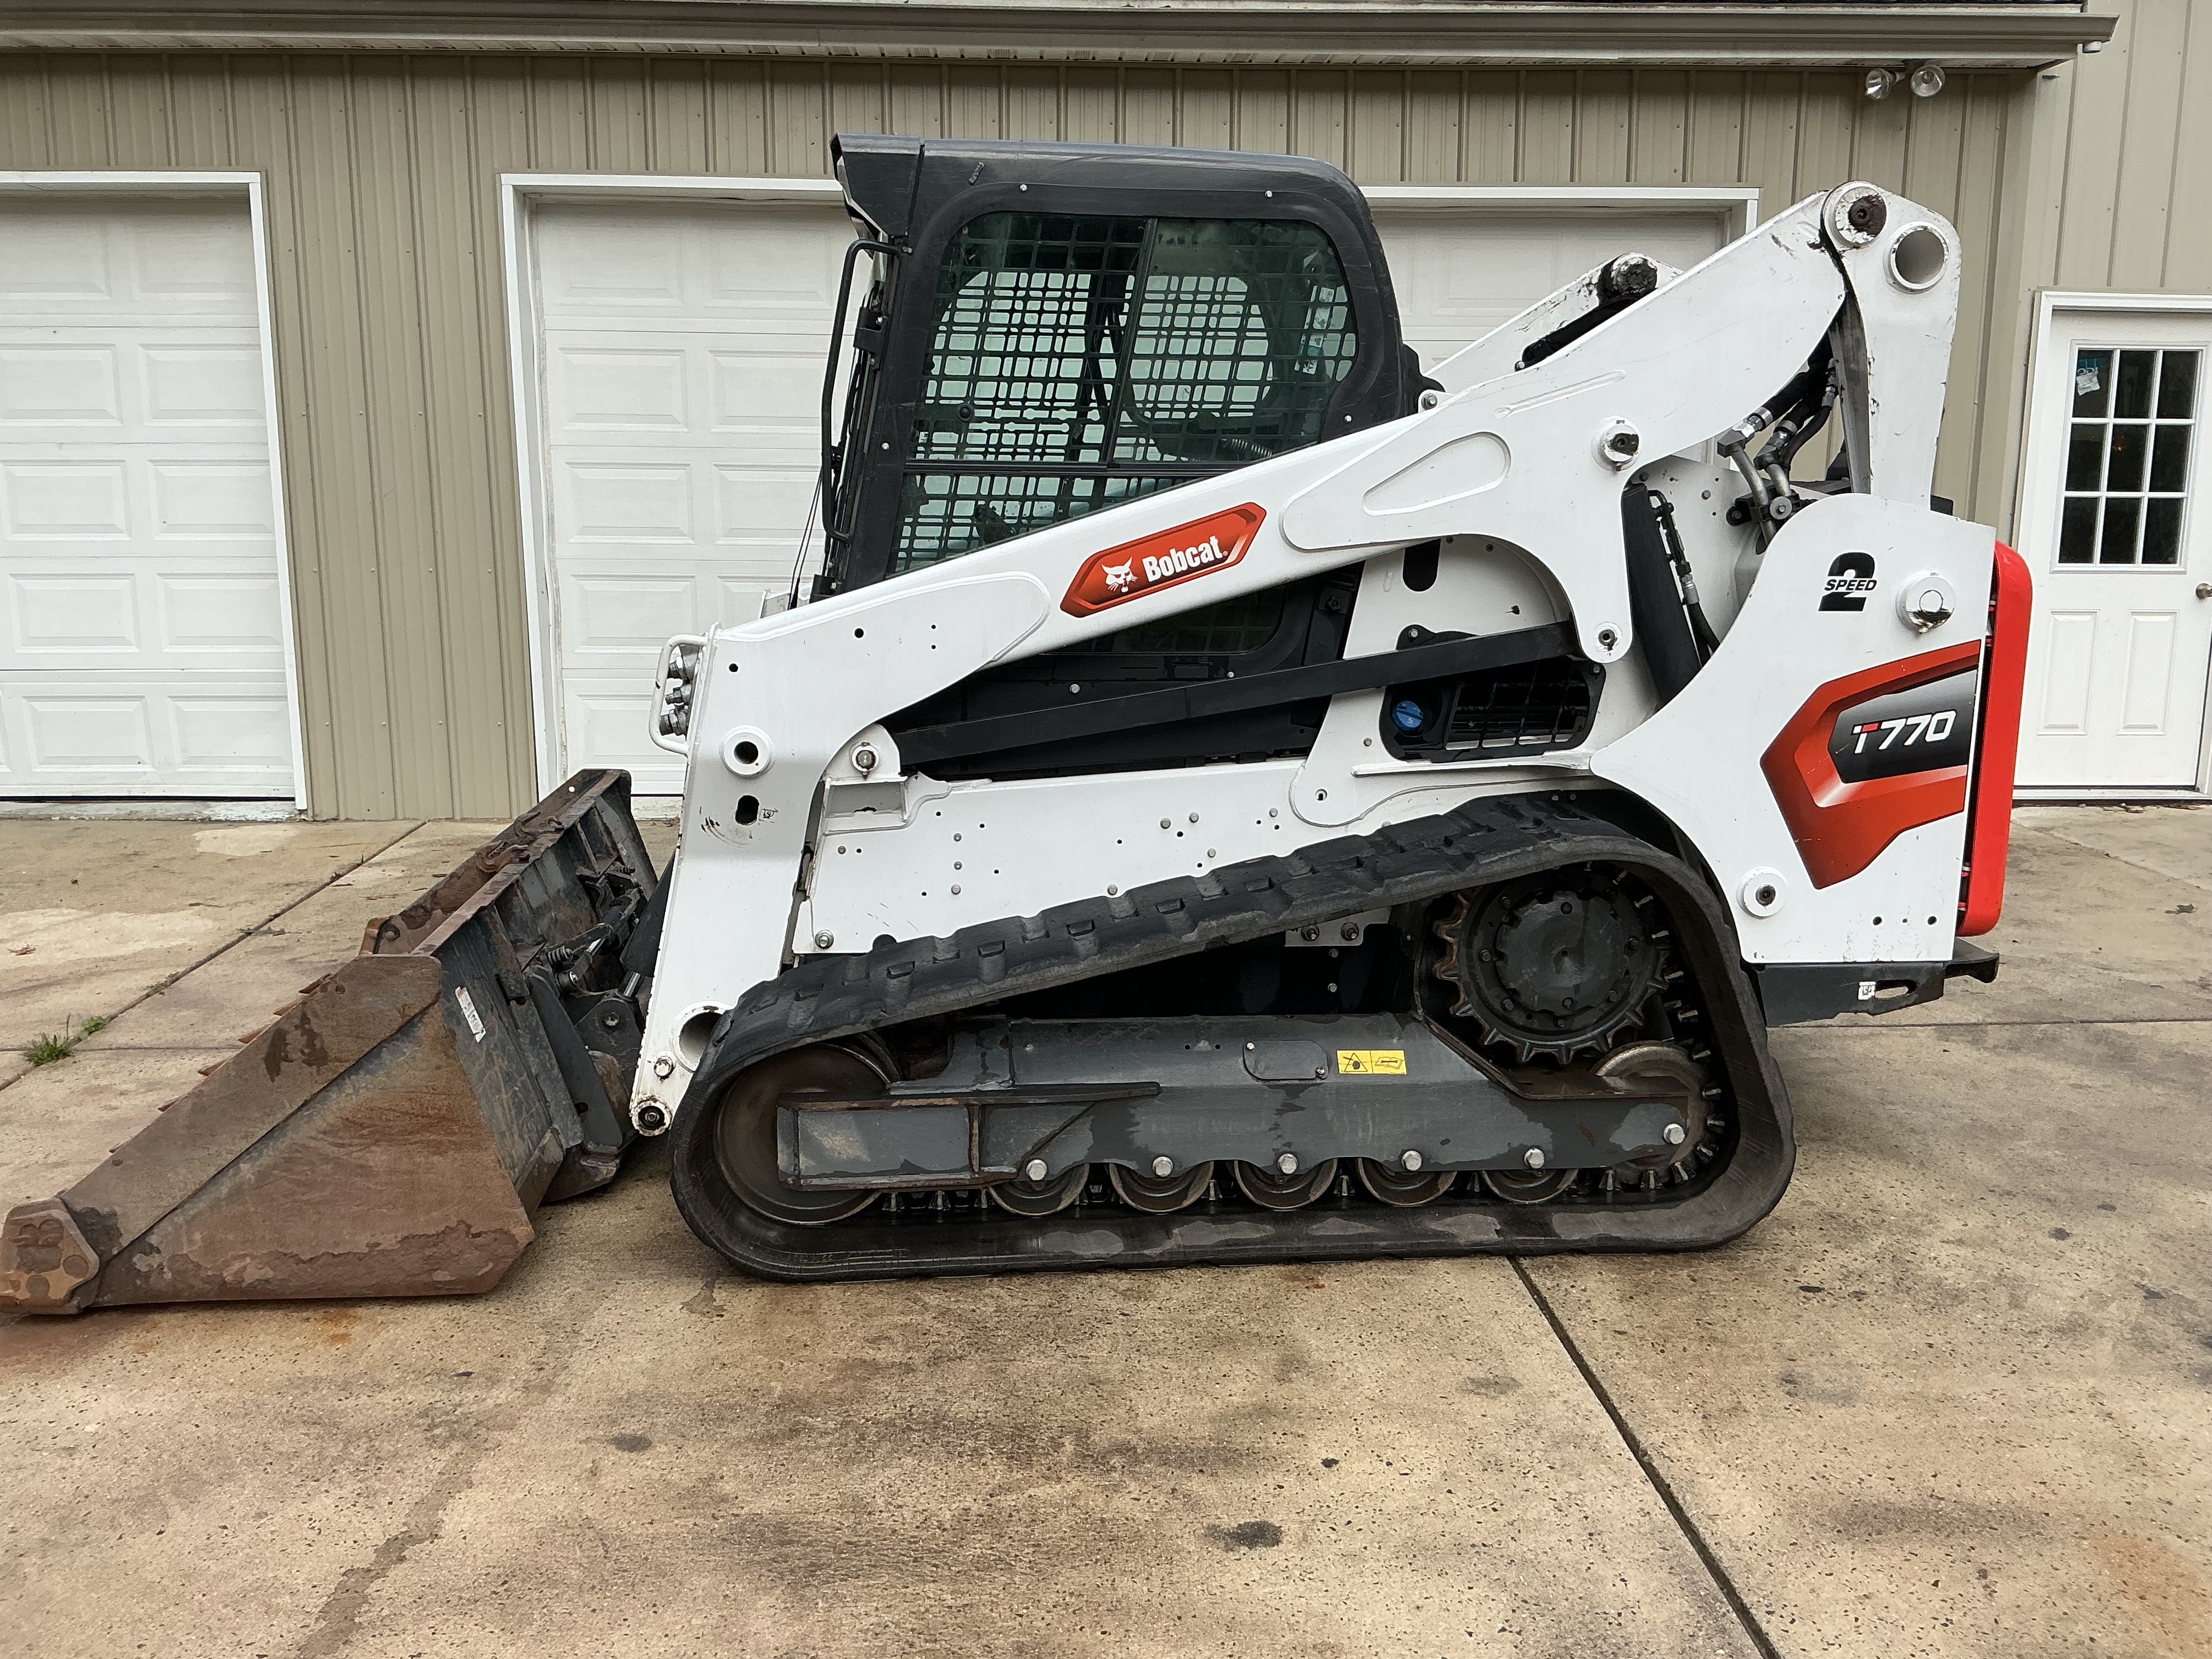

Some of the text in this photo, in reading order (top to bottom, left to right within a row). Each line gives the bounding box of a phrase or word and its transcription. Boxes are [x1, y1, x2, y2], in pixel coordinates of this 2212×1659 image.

[1142, 535, 1223, 582] Bobcat
[1819, 552, 1875, 611] 2
[1824, 579, 1877, 591] SPEED
[1852, 710, 1957, 754] T770
